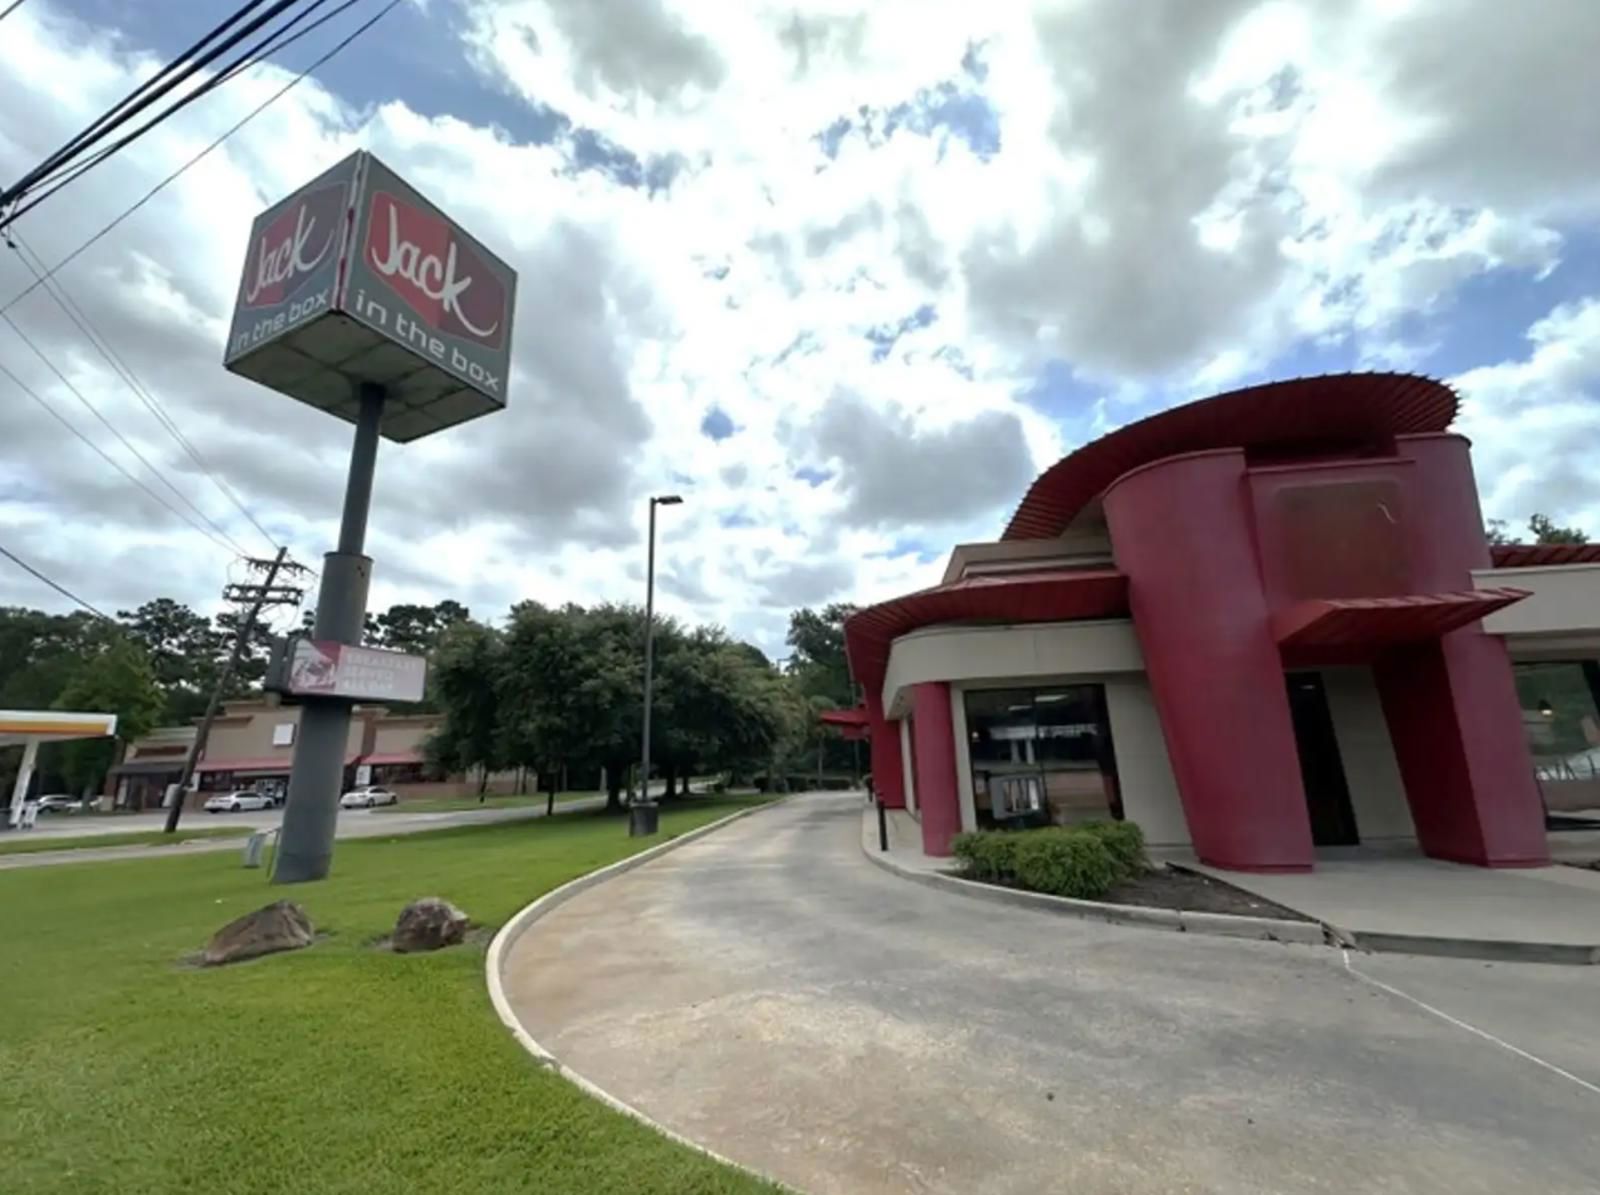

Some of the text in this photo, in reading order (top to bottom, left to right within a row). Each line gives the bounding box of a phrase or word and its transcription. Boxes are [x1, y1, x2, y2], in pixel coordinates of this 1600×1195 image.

[246, 204, 335, 302] Jack
[371, 203, 498, 337] Jack
[252, 313, 284, 342] the
[288, 288, 330, 322] box
[355, 289, 500, 392] in the box
